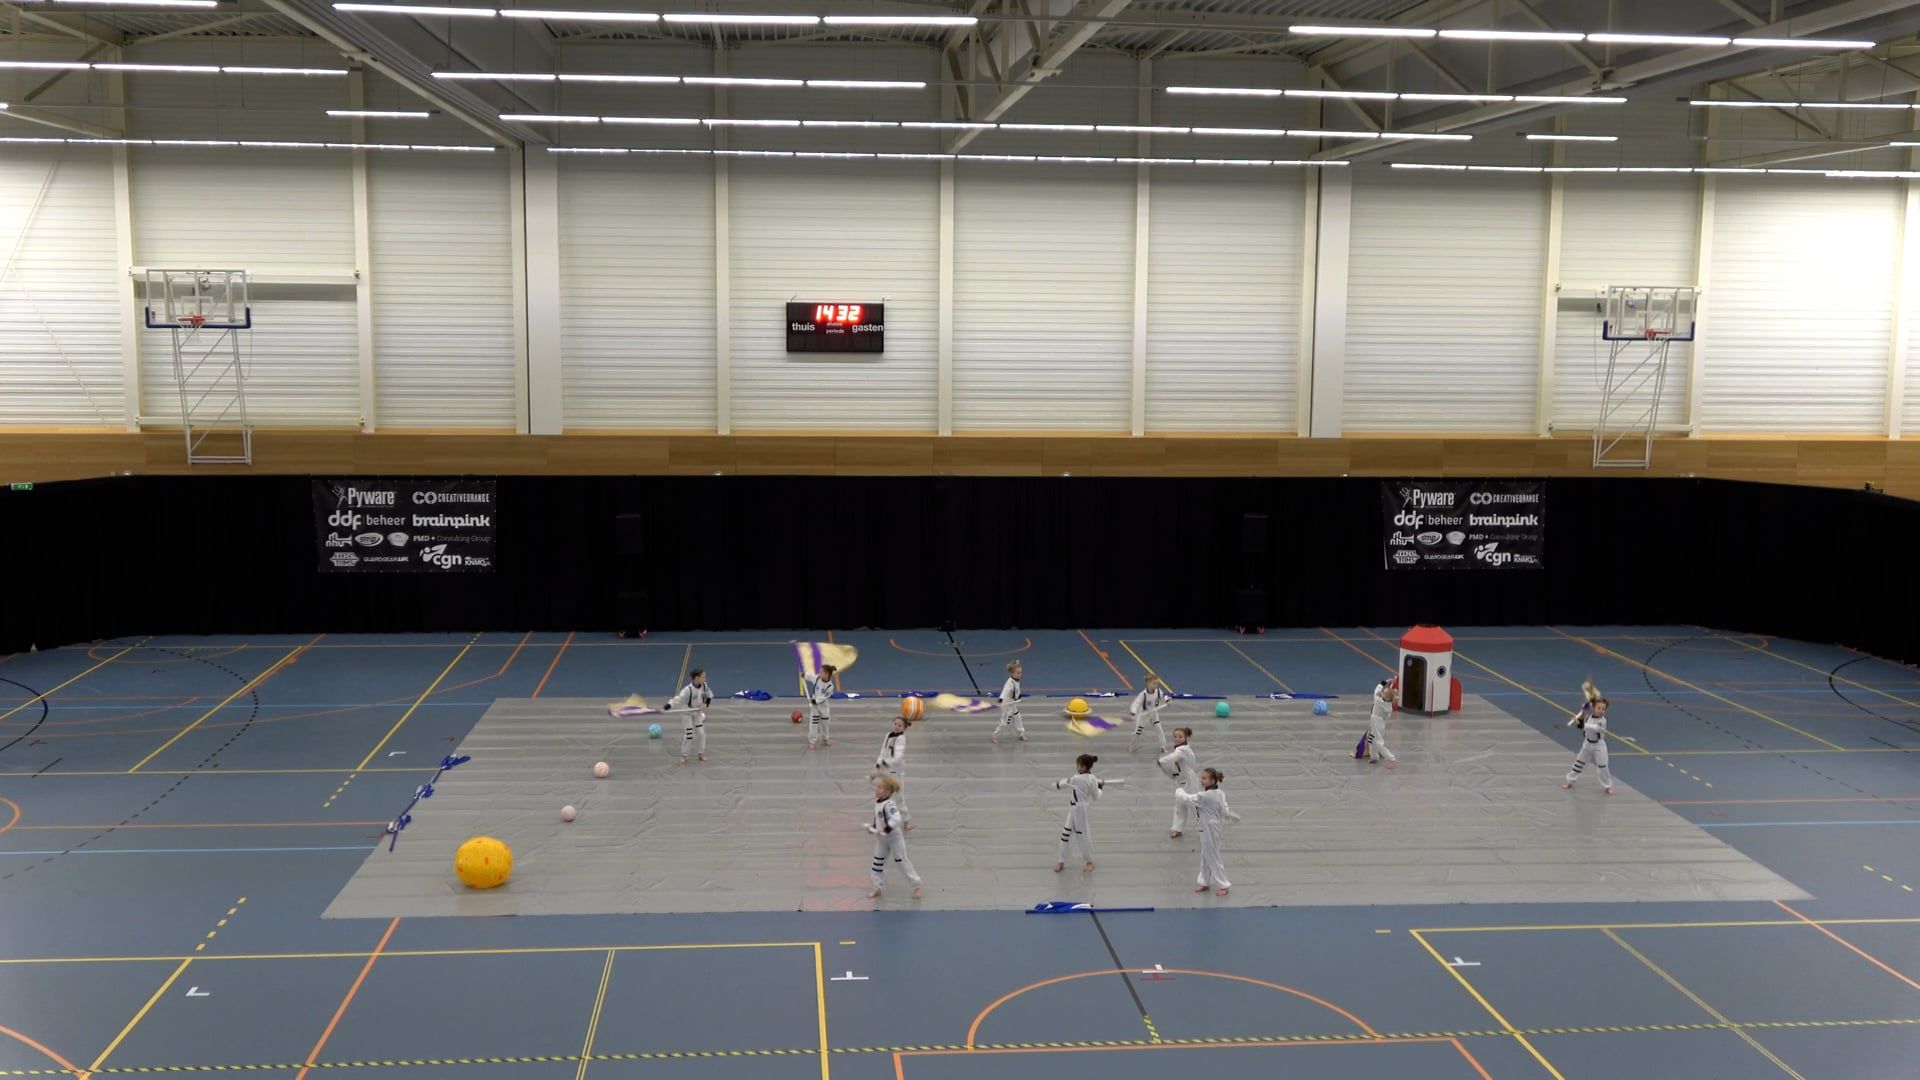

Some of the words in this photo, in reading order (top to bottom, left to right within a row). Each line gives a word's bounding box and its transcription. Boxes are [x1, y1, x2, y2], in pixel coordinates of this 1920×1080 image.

[792, 322, 815, 331] thuis
[852, 323, 884, 333] gasten
[348, 487, 395, 508] Pyware
[1413, 488, 1455, 508] Pyware
[328, 510, 362, 530] ddf
[366, 515, 405, 526] beheer
[412, 514, 490, 529] brainpink
[1394, 510, 1424, 529] ddf
[1428, 514, 1464, 525] beheer
[1469, 513, 1538, 528] brainpink
[437, 535, 470, 543] Consulting
[471, 535, 491, 543] Group
[433, 554, 462, 569] cgn
[1485, 551, 1511, 566] cgn
